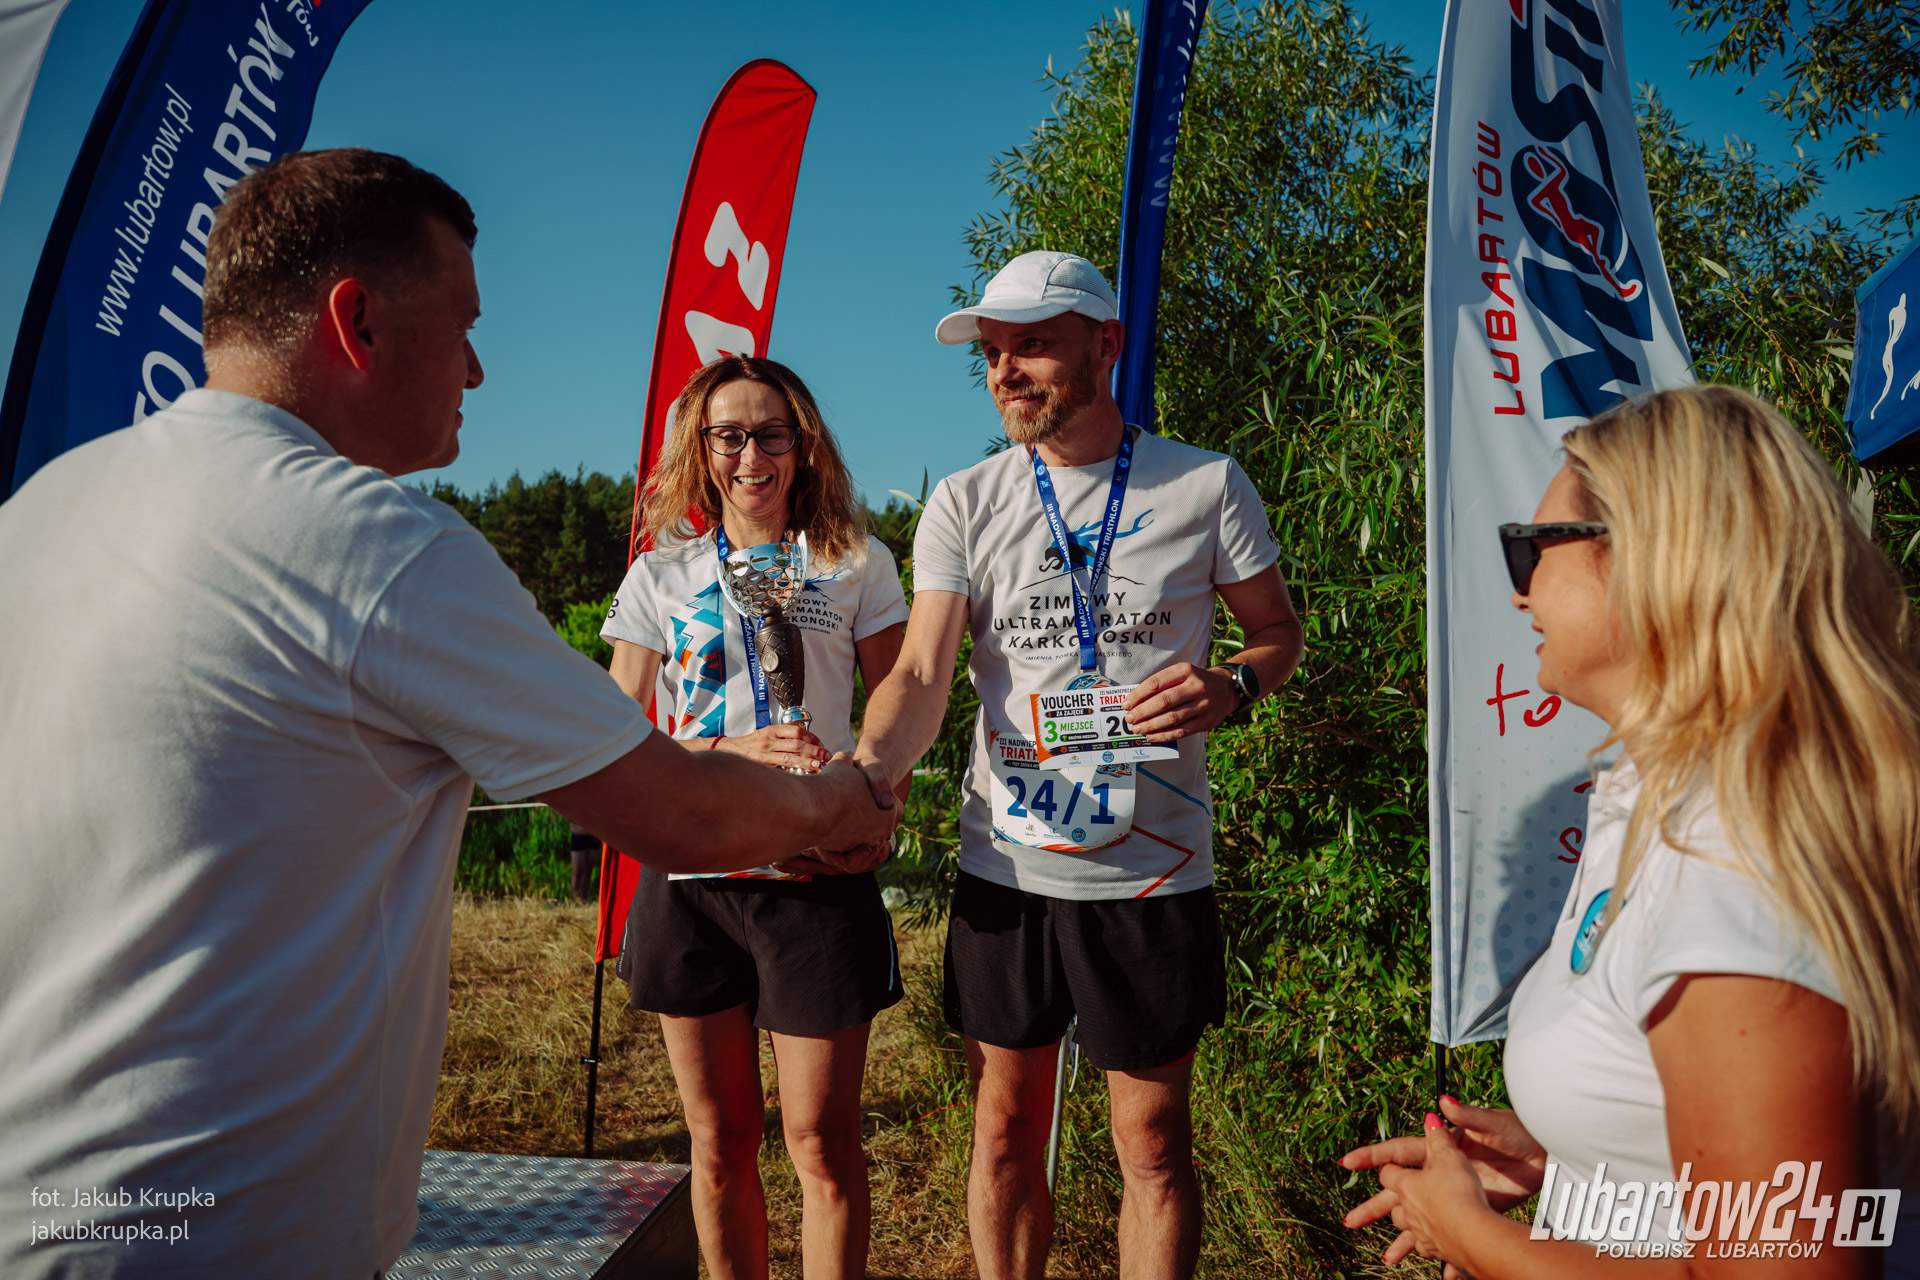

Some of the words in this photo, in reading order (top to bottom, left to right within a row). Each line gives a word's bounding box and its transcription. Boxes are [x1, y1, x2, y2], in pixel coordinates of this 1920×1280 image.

[96, 83, 194, 337] www.lubartow.pl
[1473, 120, 1526, 416] LUBARTÓW
[1103, 499, 1120, 548] TRIATHLON
[994, 611, 1172, 631] ULTRAMRATON
[1041, 693, 1094, 710] VOUCHER
[1043, 720, 1058, 743] 3
[1060, 721, 1094, 732] MIEJSCE
[1006, 776, 1115, 825] 24/1
